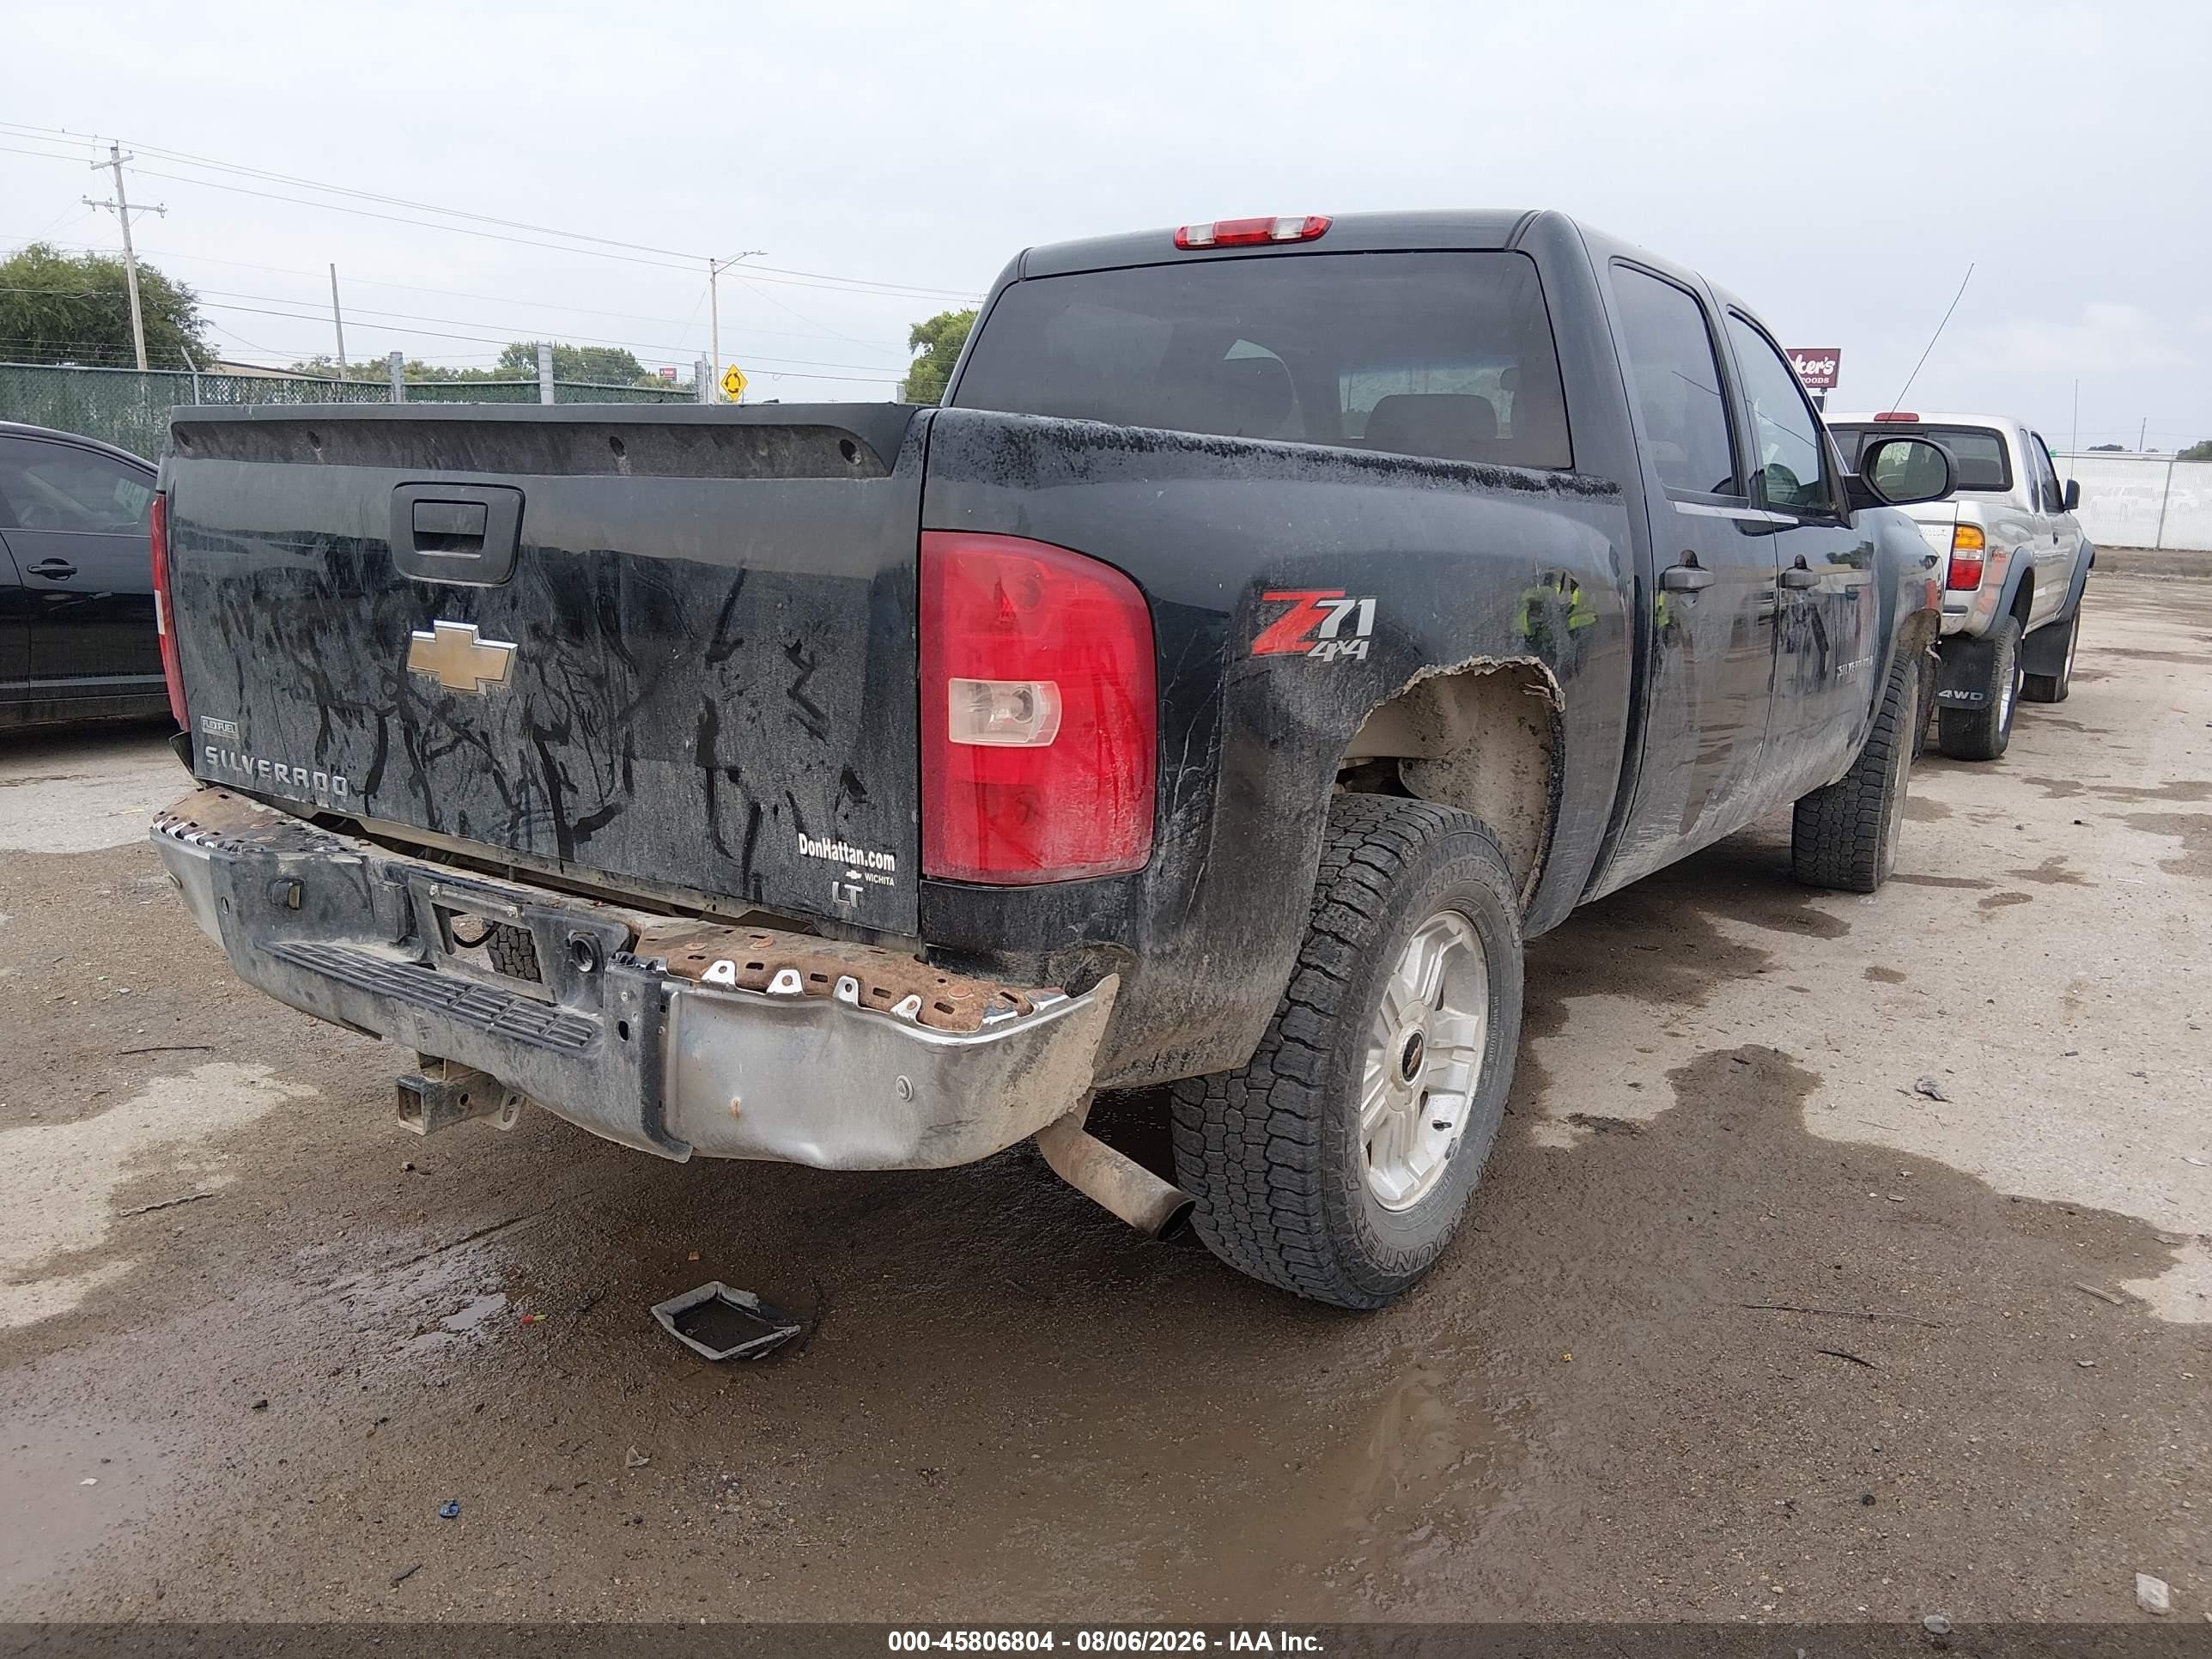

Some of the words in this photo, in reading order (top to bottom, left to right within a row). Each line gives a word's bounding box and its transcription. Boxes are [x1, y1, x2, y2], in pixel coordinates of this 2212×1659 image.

[1790, 354, 1836, 375] ker's
[1252, 590, 1376, 656] Z71
[1938, 690, 1984, 701] 4WD
[204, 744, 349, 797] SILVERADO
[798, 832, 896, 872] DonHattan.com
[864, 872, 895, 887] WICHITA
[831, 881, 864, 908] LT
